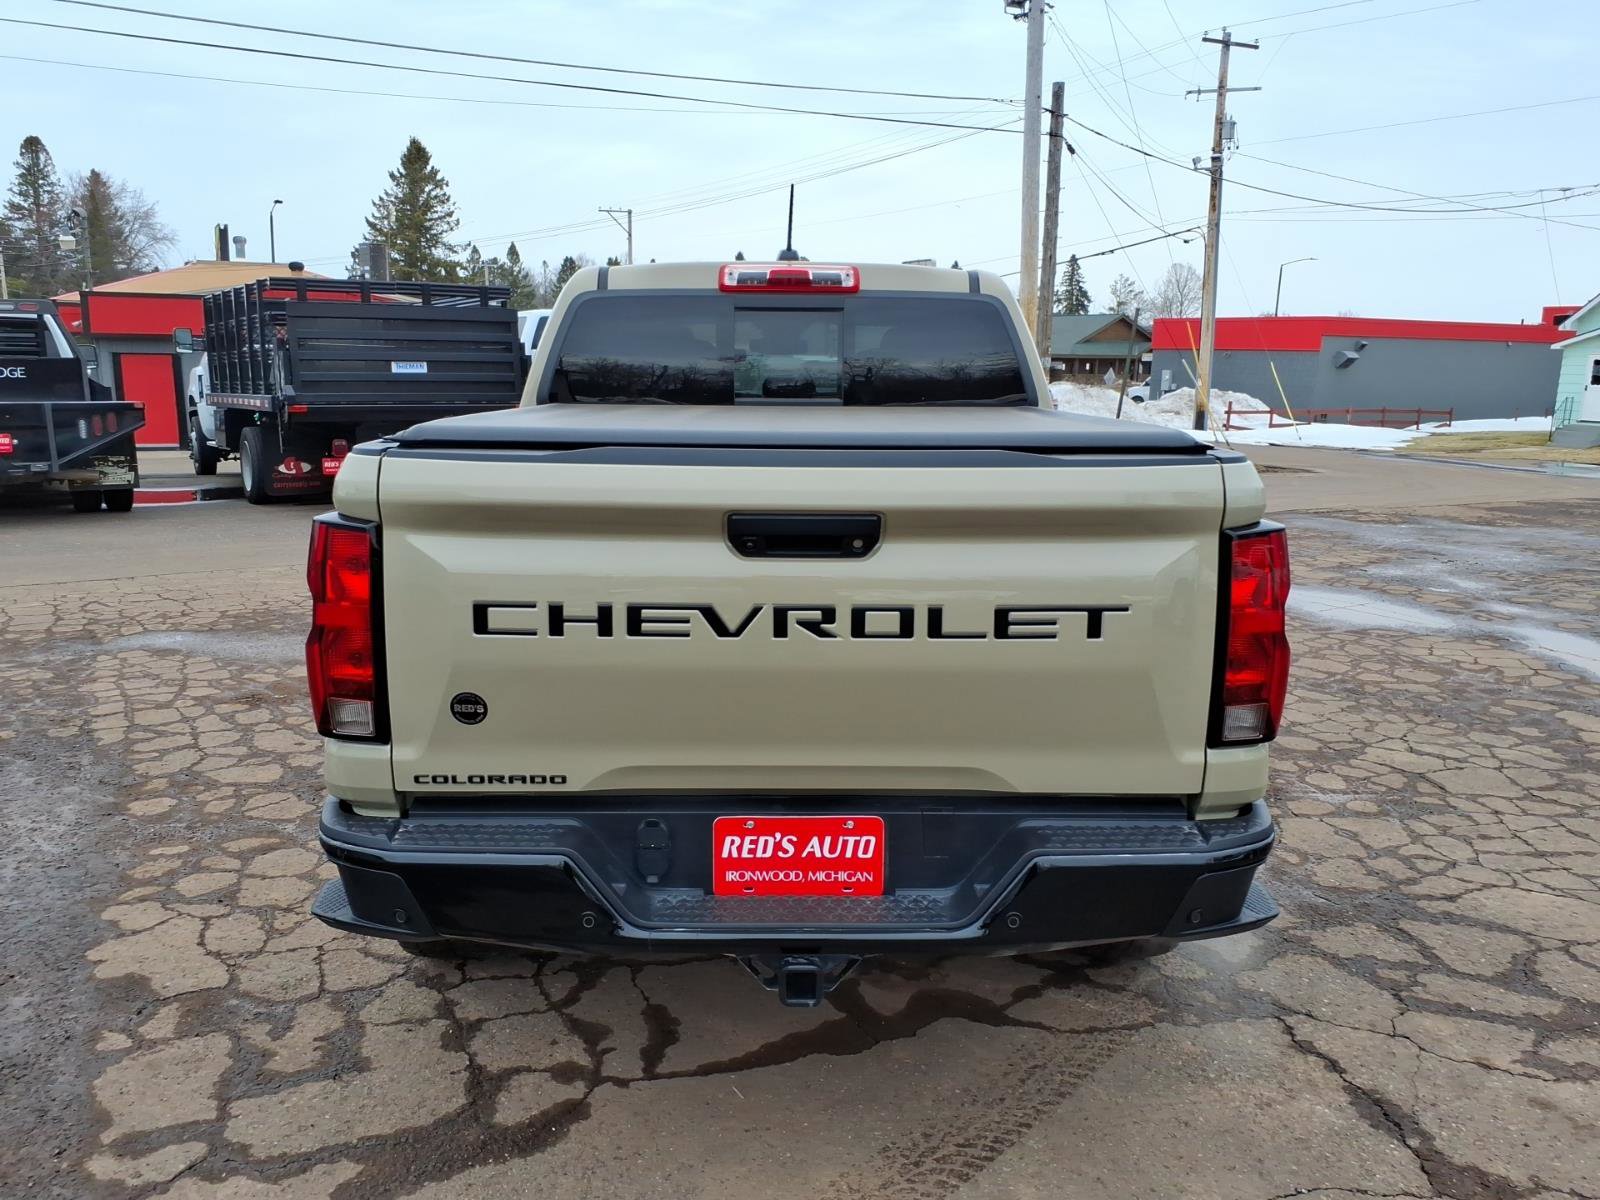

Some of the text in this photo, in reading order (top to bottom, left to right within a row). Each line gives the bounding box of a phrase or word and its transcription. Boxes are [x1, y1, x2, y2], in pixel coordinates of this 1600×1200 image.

[472, 601, 1132, 639] CHEVROLET
[453, 703, 484, 713] RED'S
[413, 774, 567, 784] COLORADO
[721, 831, 876, 859] RED'S AUTO
[725, 870, 873, 883] IRONWOOD, MICHIGAN
